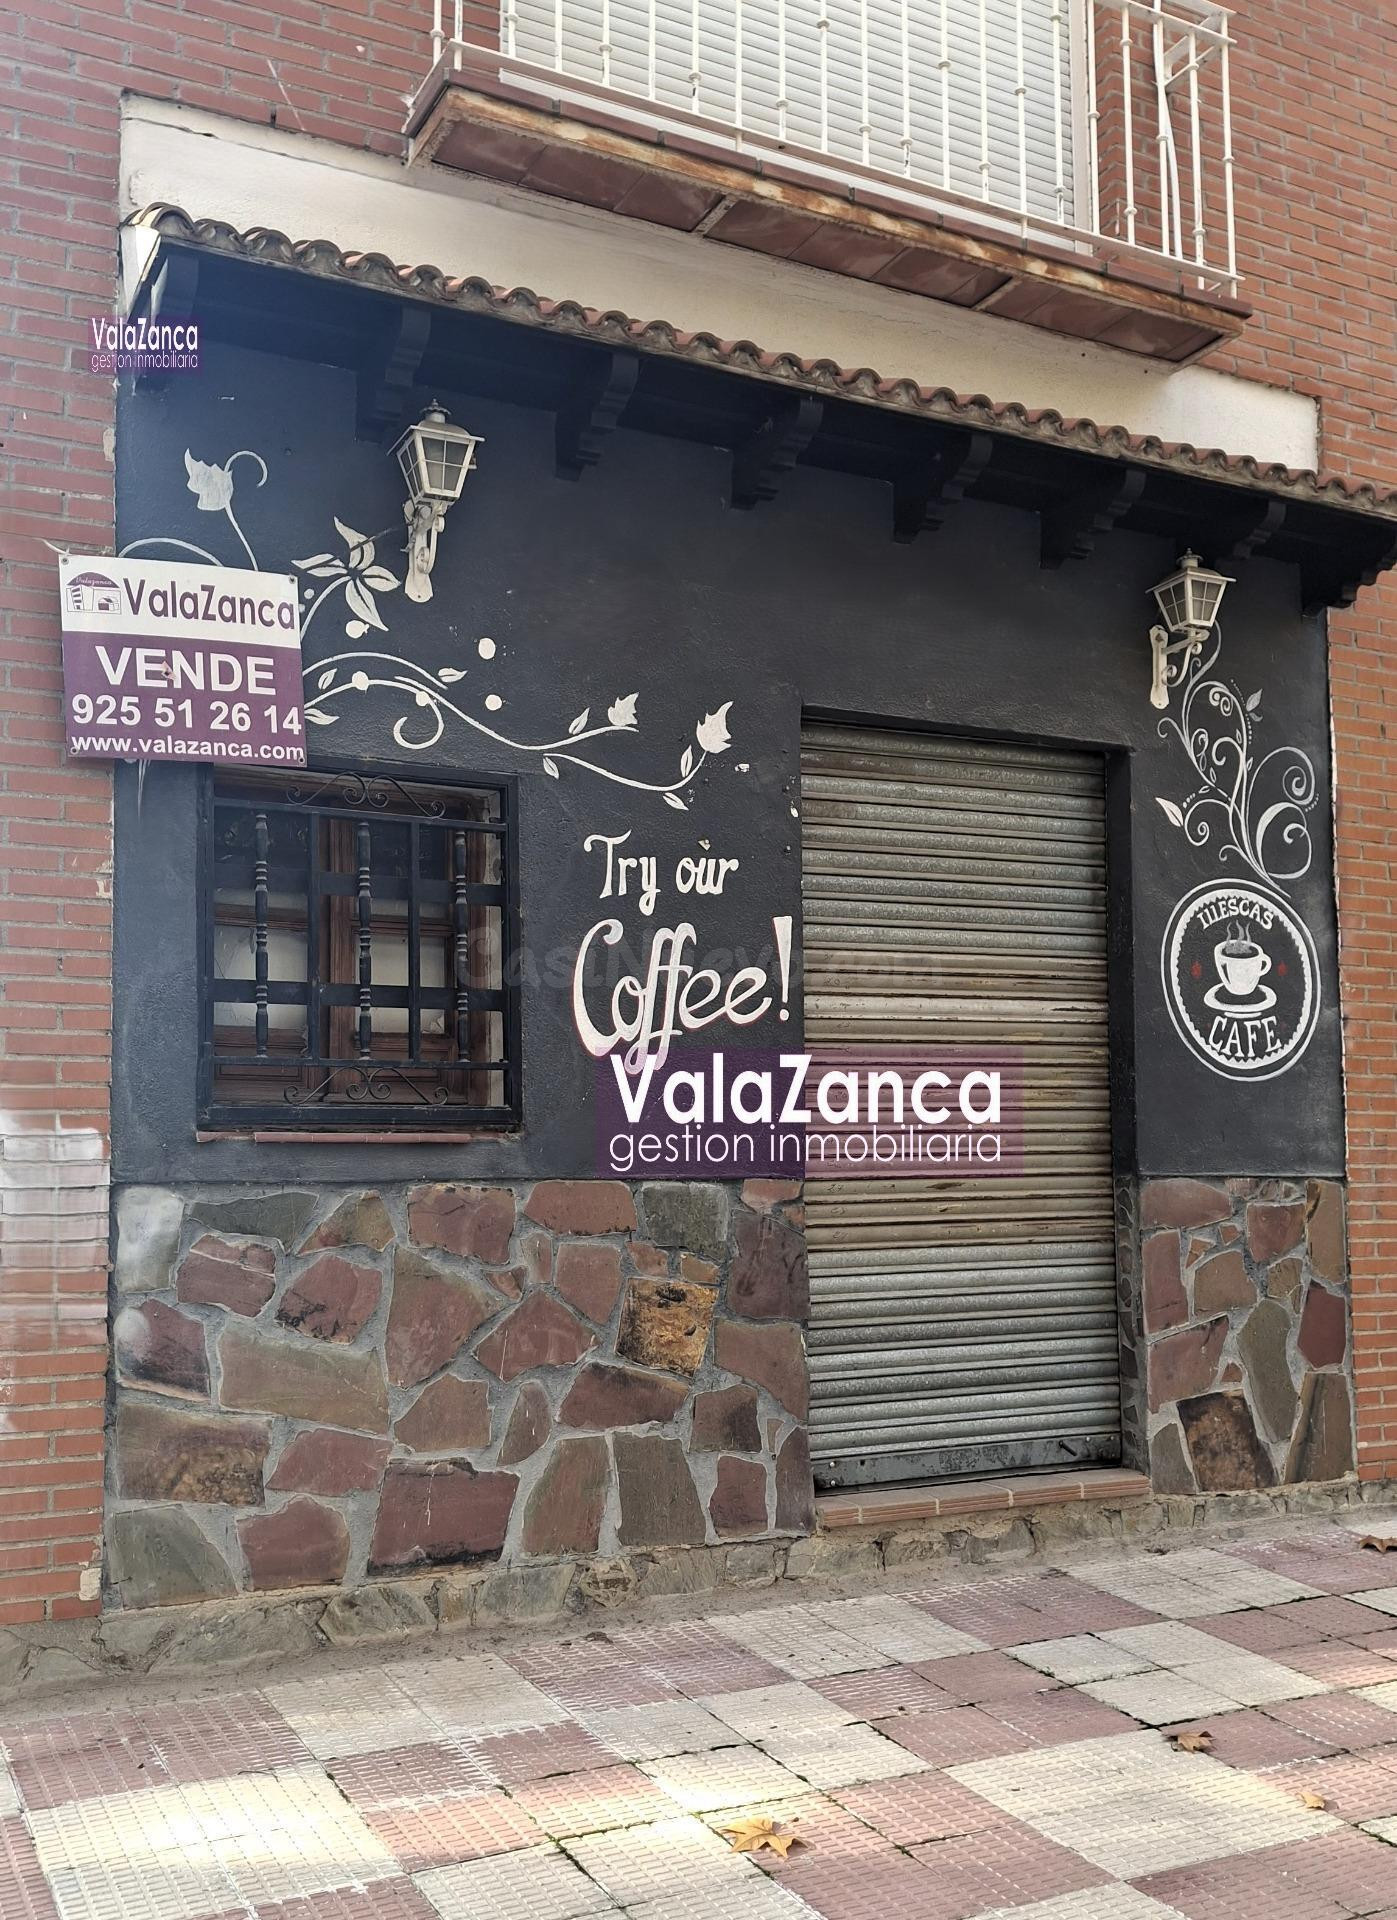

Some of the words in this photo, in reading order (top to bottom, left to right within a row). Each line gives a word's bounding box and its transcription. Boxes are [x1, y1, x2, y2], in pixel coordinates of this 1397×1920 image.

[122, 577, 295, 630] ValaZanca
[95, 645, 277, 696] VENDE
[72, 693, 142, 726] 925
[154, 697, 194, 729] 51
[209, 700, 251, 732] 26
[263, 704, 302, 735] 14
[71, 735, 304, 760] www.valazanca.com
[583, 829, 661, 916] Try
[675, 856, 739, 895] our
[573, 915, 793, 1075] Coffee!
[1208, 1015, 1283, 1058] CAFE
